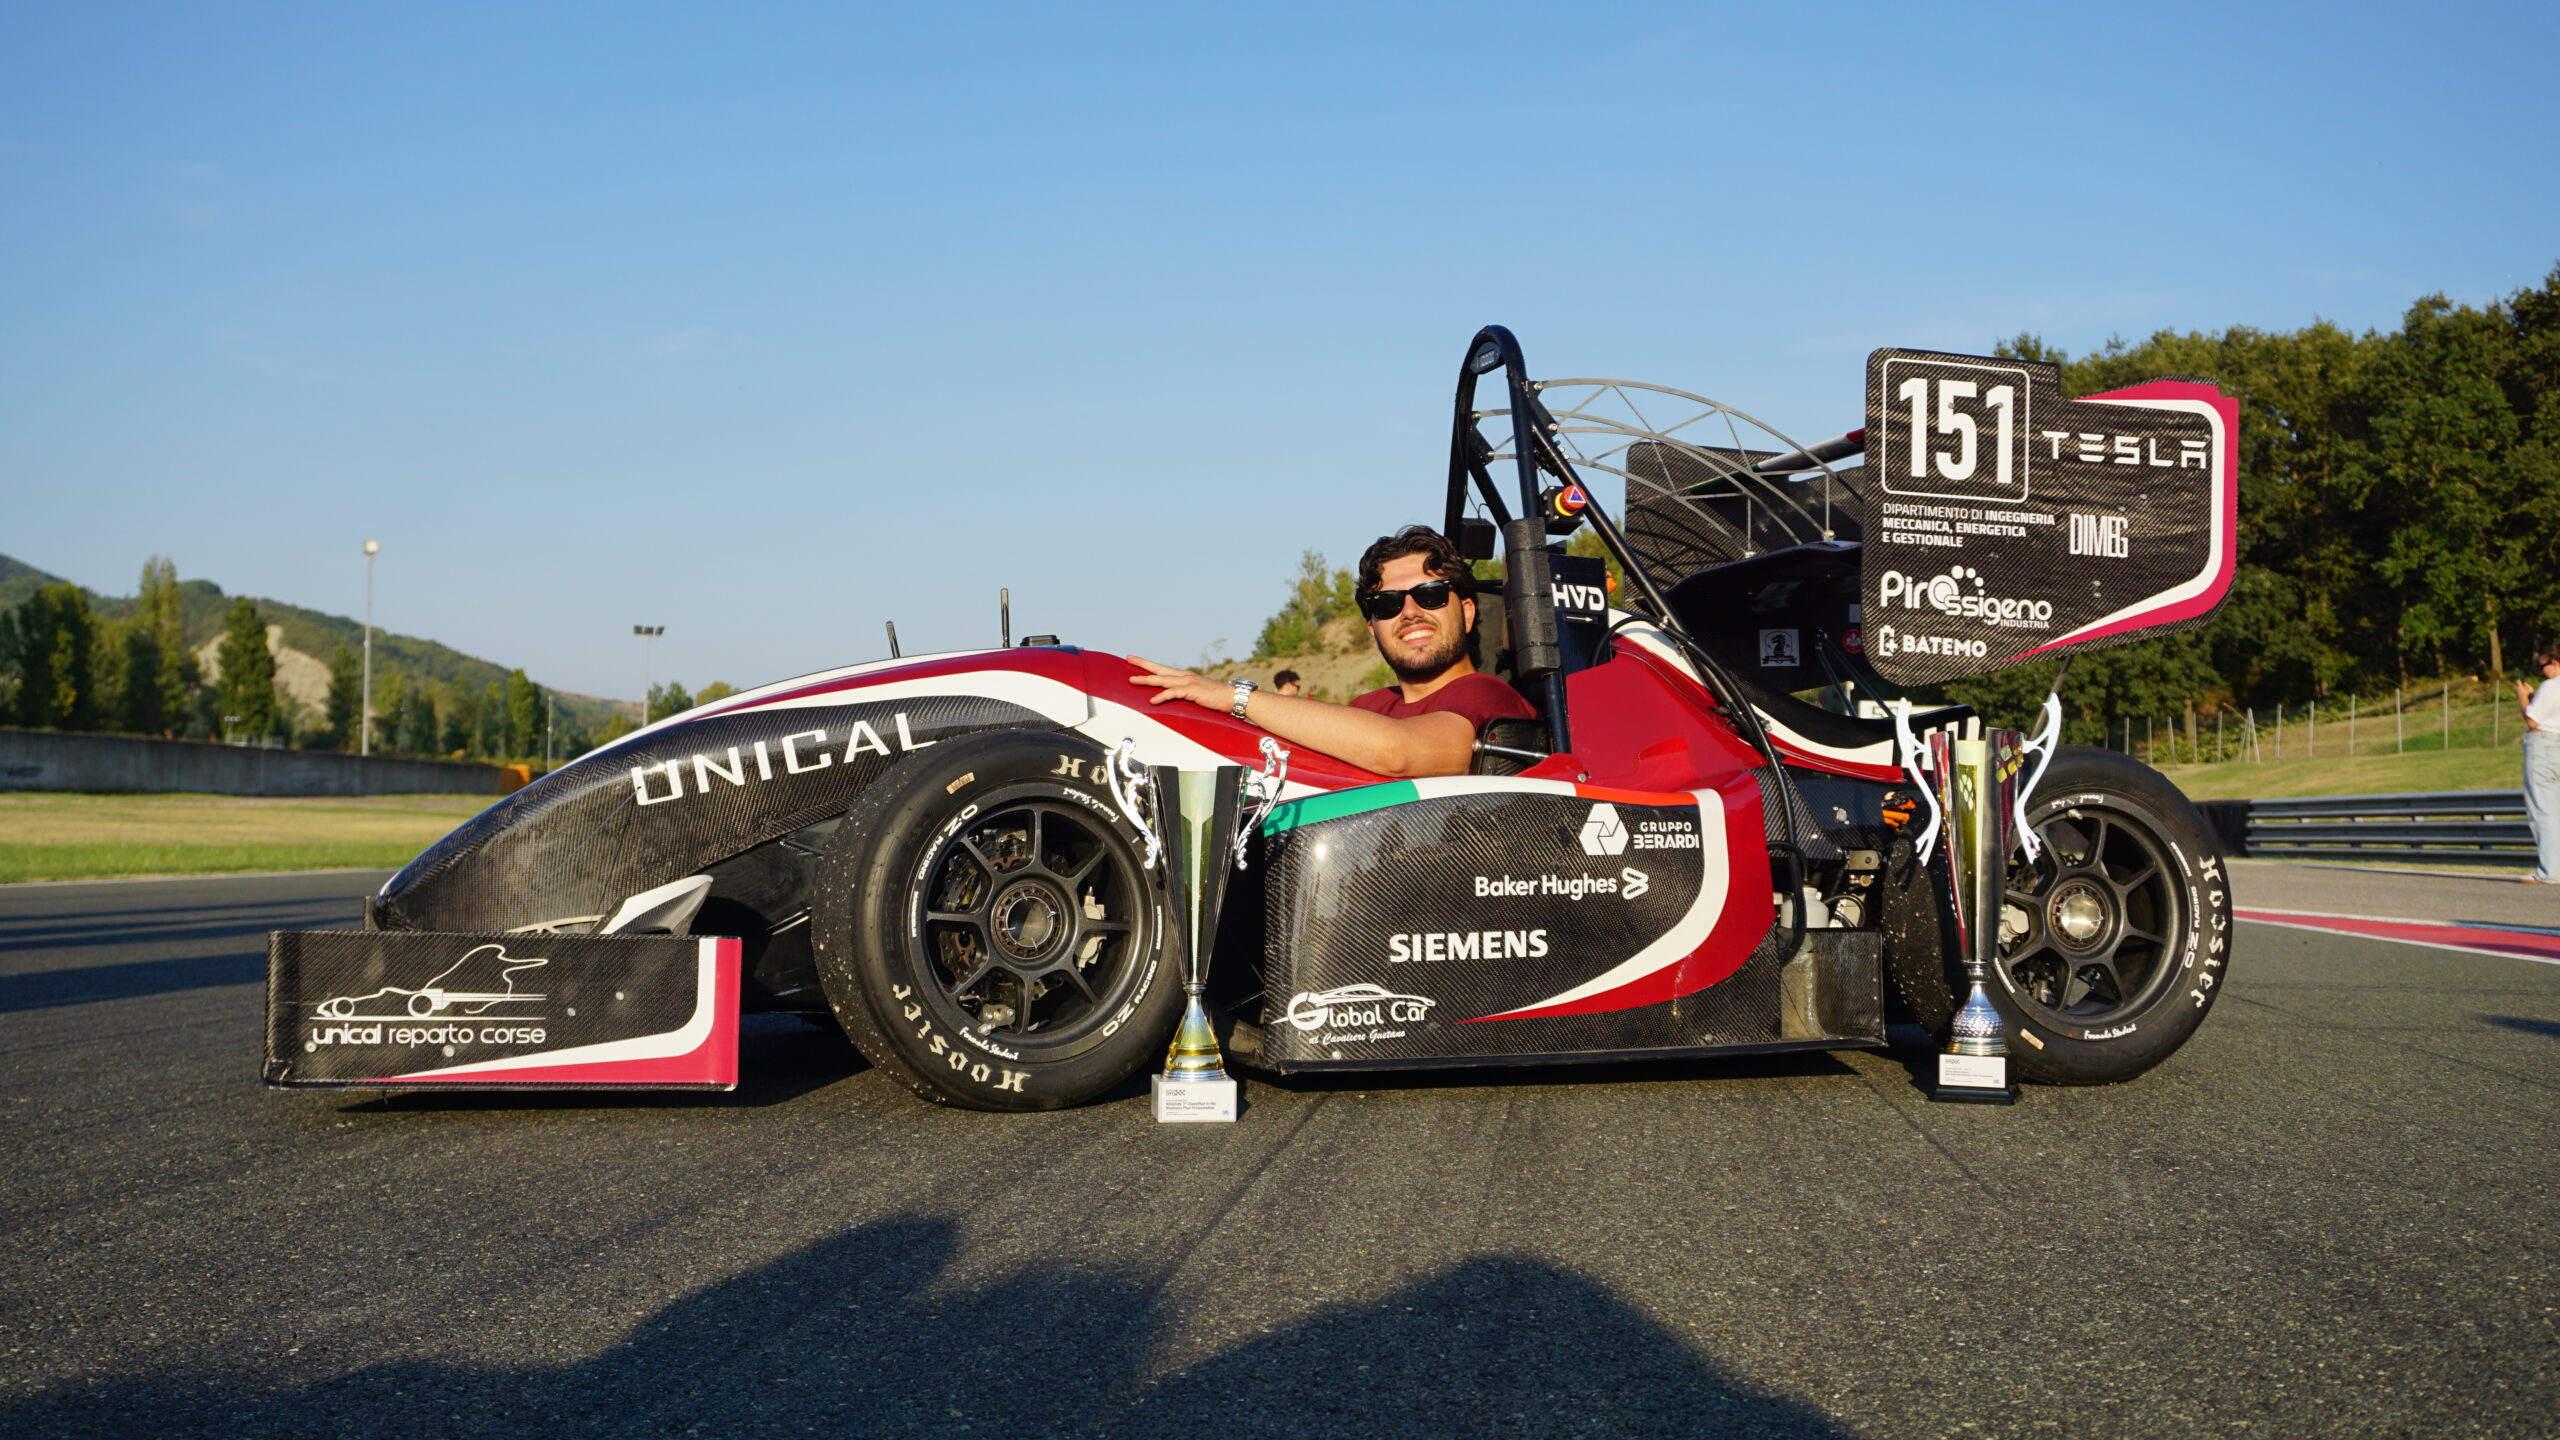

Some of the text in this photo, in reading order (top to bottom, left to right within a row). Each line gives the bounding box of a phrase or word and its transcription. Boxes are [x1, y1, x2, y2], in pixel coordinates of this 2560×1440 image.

[1899, 378, 2014, 484] 151
[2041, 430, 2207, 469] TESLA
[1882, 517, 2027, 537] MECCANICA, ENERGETICA
[1883, 502, 2056, 526] DIPARTIMENTO DI INGEGNERIA
[1882, 531, 1964, 548] E GESTIONALE
[2069, 513, 2129, 558] DIMEG
[1551, 583, 1605, 611] HVD
[2000, 619, 2050, 629] INDUSTRIA
[1902, 634, 1988, 658] BATEMO
[630, 712, 938, 806] UNICAL
[1639, 821, 1692, 833] GRUPPO
[1633, 834, 1700, 849] BERARDI
[918, 835, 944, 880] RACING
[1474, 872, 1617, 901] Baker Hughes
[2190, 885, 2201, 928] RACING
[1389, 929, 1549, 963] SIEMENS
[1134, 960, 1158, 1004] RACING
[1286, 992, 1428, 1031] Global Car
[312, 1023, 547, 1049] unical reparto corse
[1369, 1028, 1406, 1043] Gaetano
[989, 1043, 1020, 1060] Student
